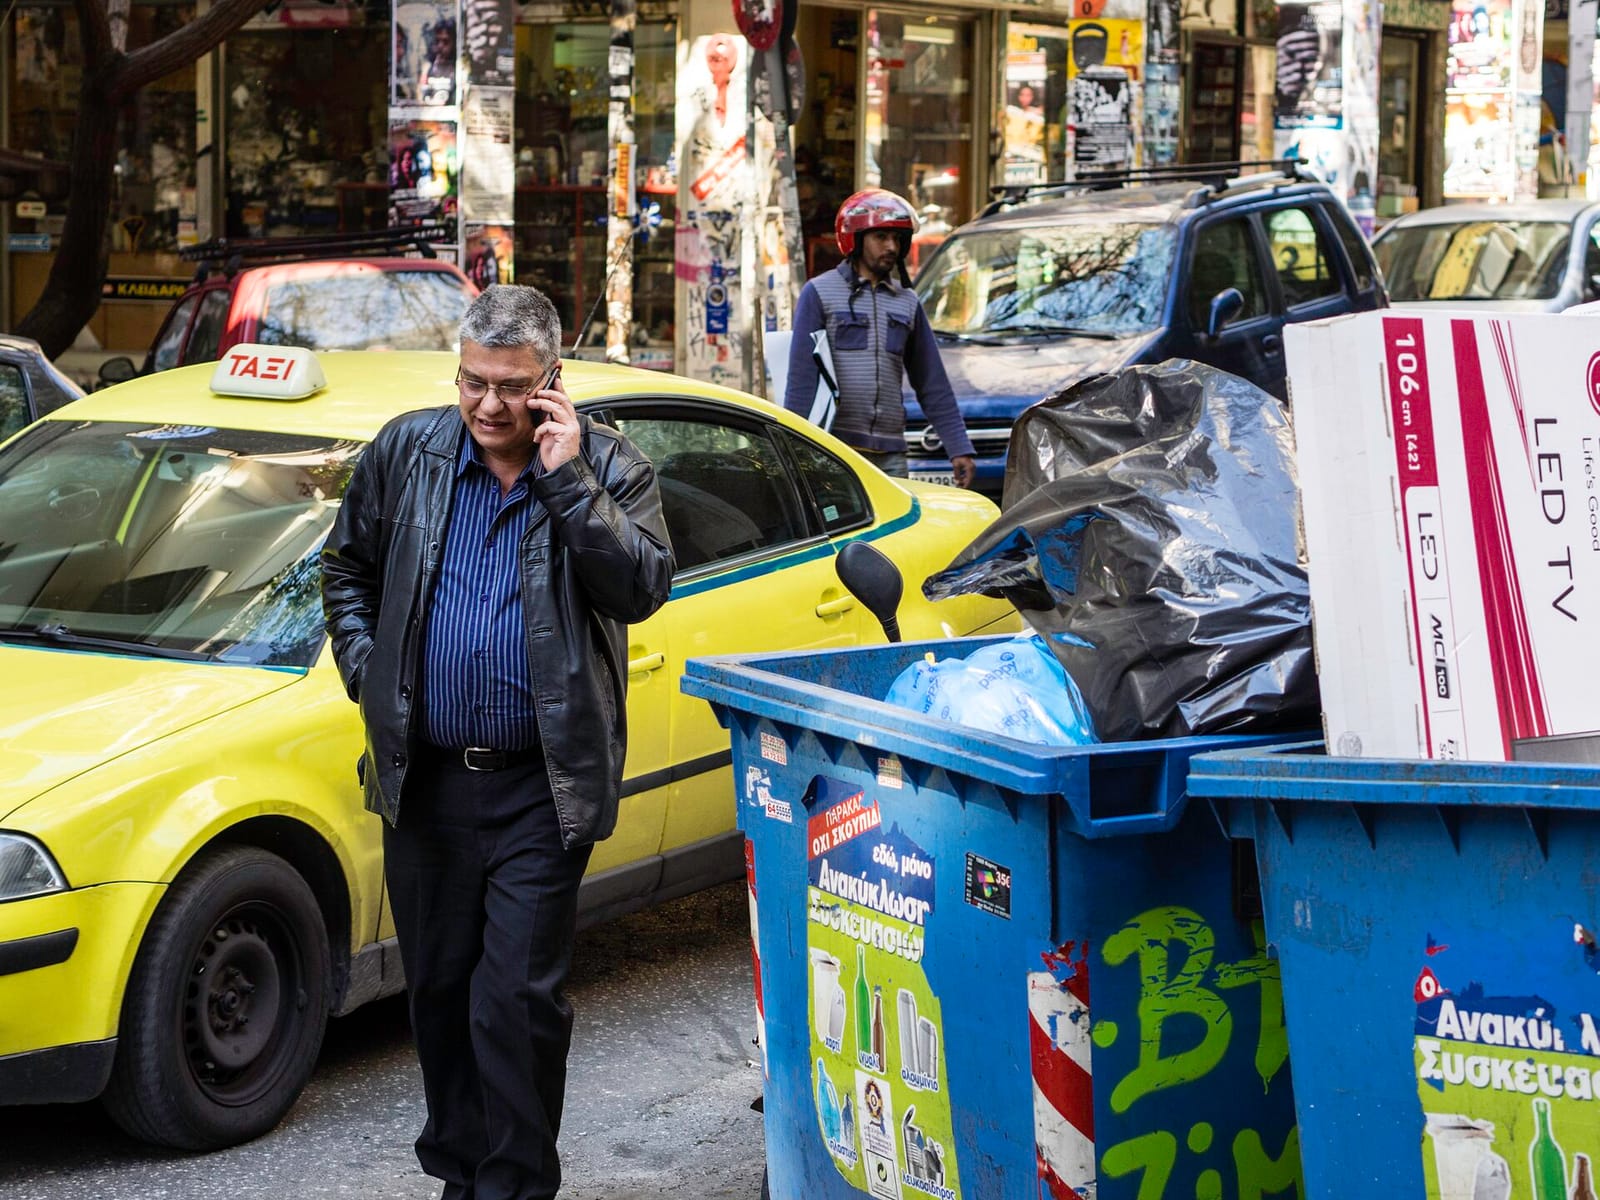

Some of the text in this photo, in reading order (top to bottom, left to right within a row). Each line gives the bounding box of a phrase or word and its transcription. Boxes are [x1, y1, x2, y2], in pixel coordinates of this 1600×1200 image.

[229, 354, 295, 381] ΤΑΞΙ
[1395, 333, 1420, 396] 106
[1402, 400, 1412, 426] cm
[1582, 437, 1600, 551] Life's Good
[1534, 418, 1577, 622] LED TV
[1417, 513, 1438, 581] LED
[825, 794, 863, 828] ΠΑΡΑΚΑ
[812, 833, 831, 856] ΟΧΙ
[901, 853, 932, 879] μόνο
[1417, 1039, 1600, 1100] Συσκευα
